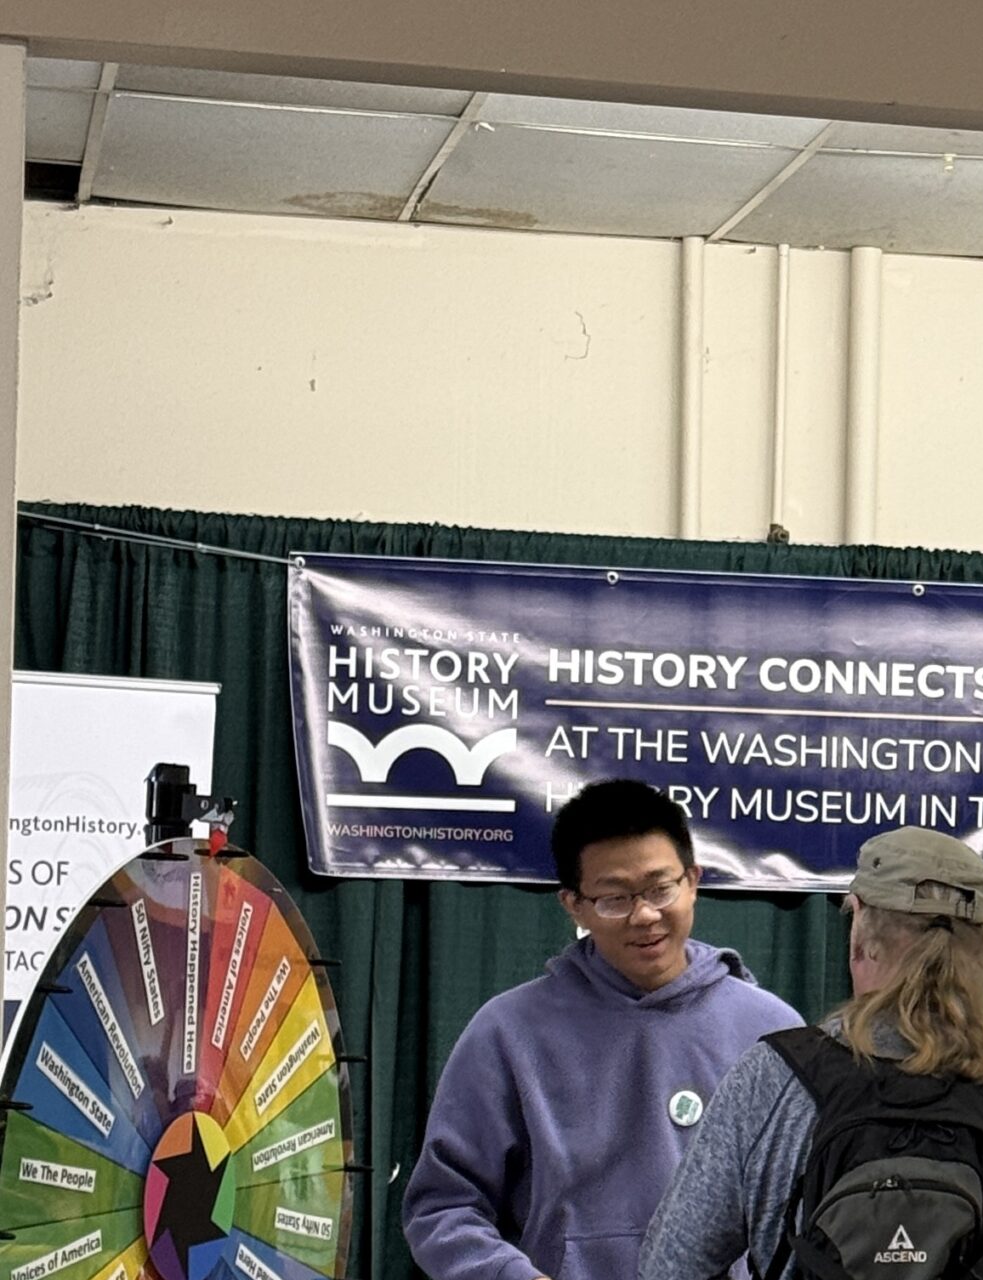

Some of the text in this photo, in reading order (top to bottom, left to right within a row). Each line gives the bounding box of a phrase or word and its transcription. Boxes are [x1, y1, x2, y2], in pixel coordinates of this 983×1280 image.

[330, 624, 520, 643] WASHINGTON STATE
[328, 645, 520, 685] HISTORY
[548, 648, 748, 689] HISTORY
[327, 681, 518, 719] MUSEUM
[545, 725, 599, 758] AT
[608, 727, 689, 762] THE
[701, 730, 981, 774] WASHINGTON
[731, 786, 906, 826] MUSEUM
[921, 795, 957, 827] IN
[326, 824, 514, 842] WASHINGTONHISTORY.ORG
[31, 860, 70, 886] OF
[134, 902, 161, 1020] 50 Nifty States
[184, 875, 200, 1071] History Happened Here
[213, 907, 251, 1045] Voices of America
[78, 960, 142, 1096] American Revolution
[242, 962, 289, 1057] We The People
[256, 1027, 320, 1107] Washington State
[40, 1047, 112, 1131] Washington State
[253, 1121, 334, 1166] American Revolution
[21, 1161, 93, 1189] We The People
[277, 1213, 332, 1237] 50 Nifty States
[48, 1254, 59, 1270] of
[60, 1236, 101, 1265] America
[238, 1249, 257, 1271] Here
[873, 1251, 928, 1264] ASCEND
